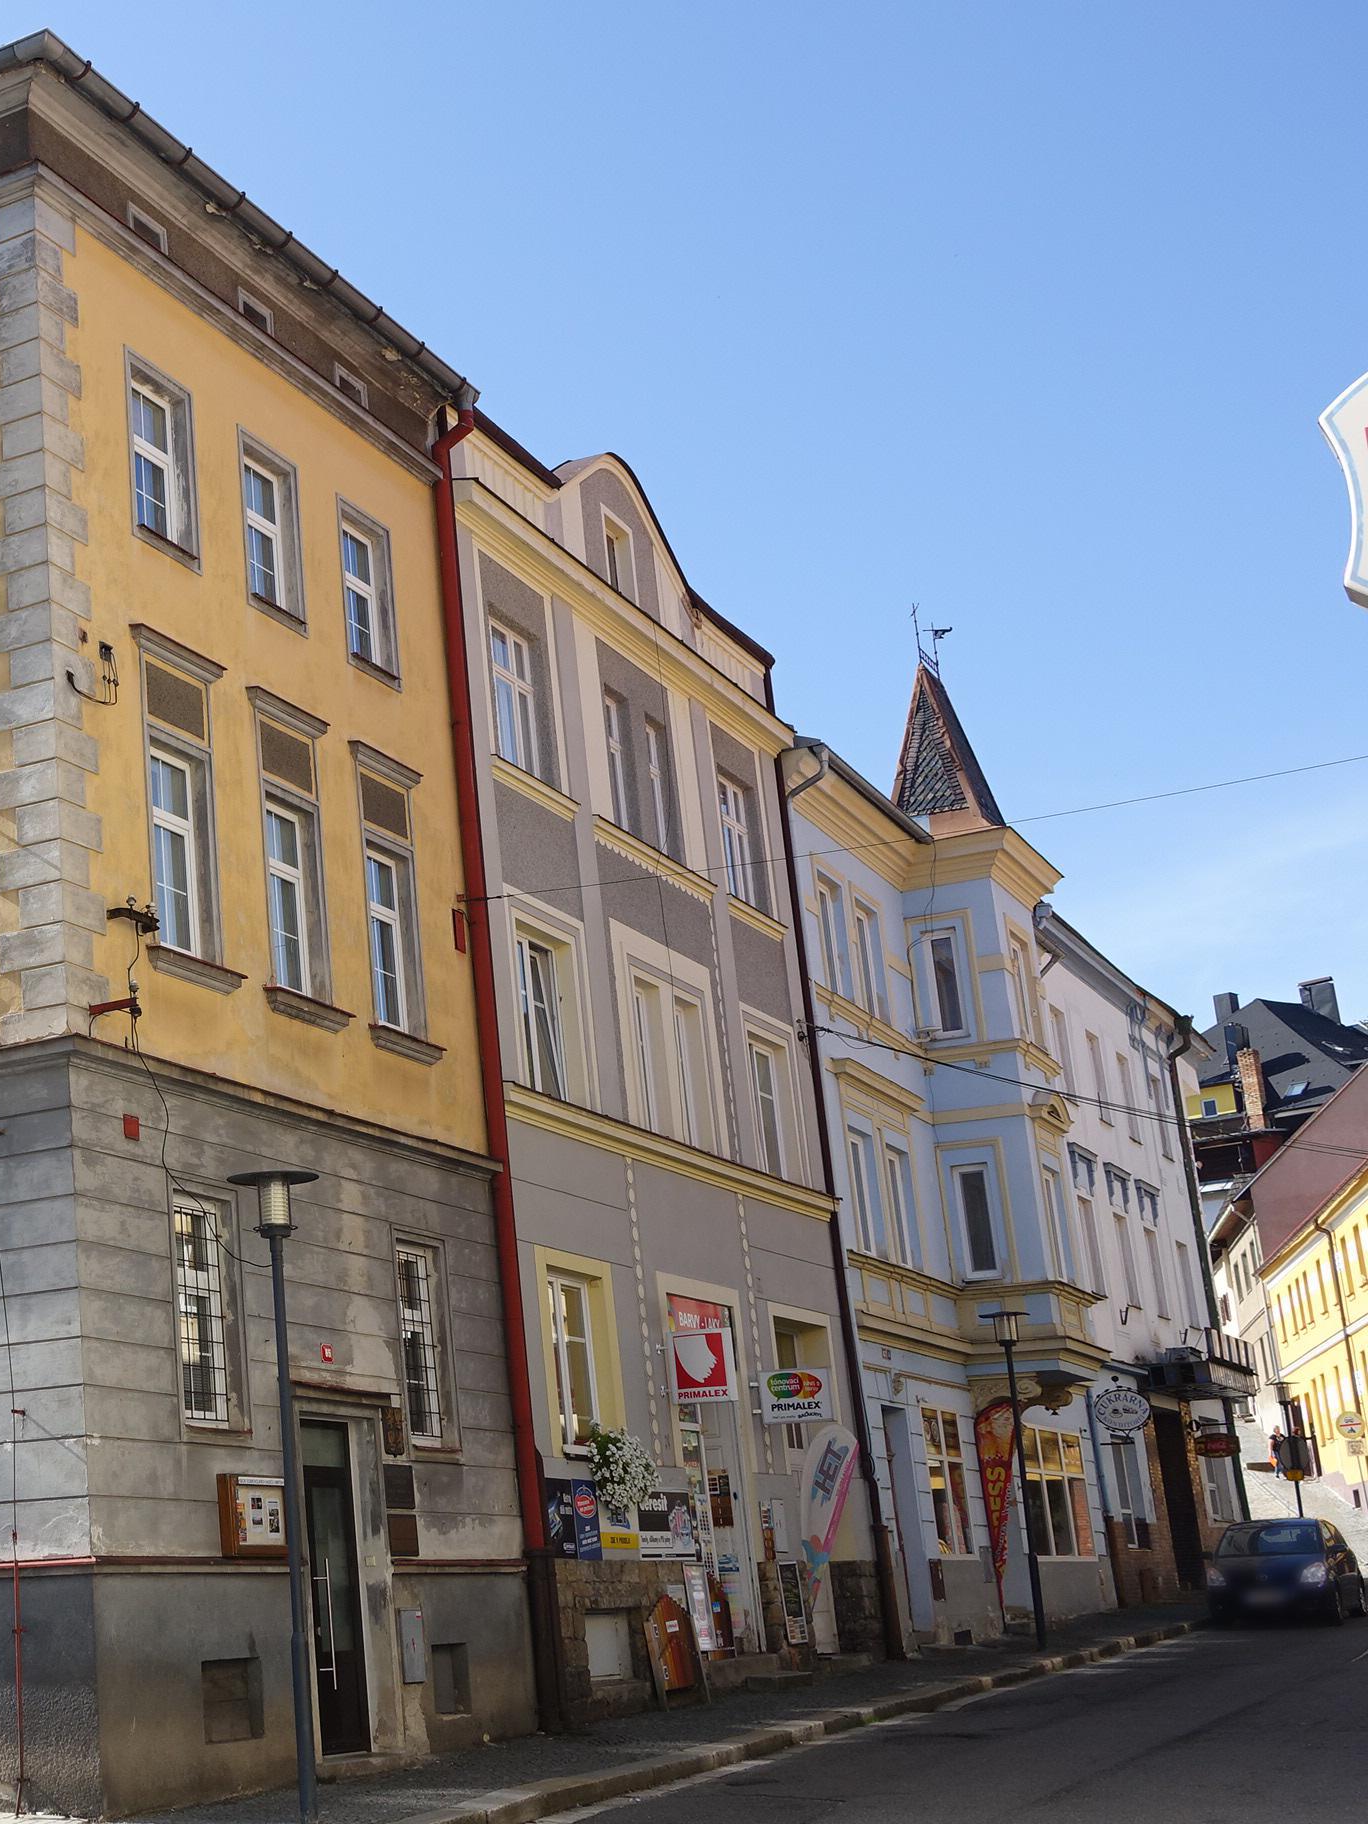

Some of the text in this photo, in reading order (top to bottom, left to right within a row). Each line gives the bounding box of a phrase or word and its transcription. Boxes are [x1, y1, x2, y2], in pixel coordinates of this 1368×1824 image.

[678, 1311, 700, 1329] BARVY
[678, 1389, 729, 1400] PRIMALEX
[770, 1384, 801, 1393] centrum
[771, 1400, 821, 1412] PRIMALEX
[814, 1440, 844, 1497] HET
